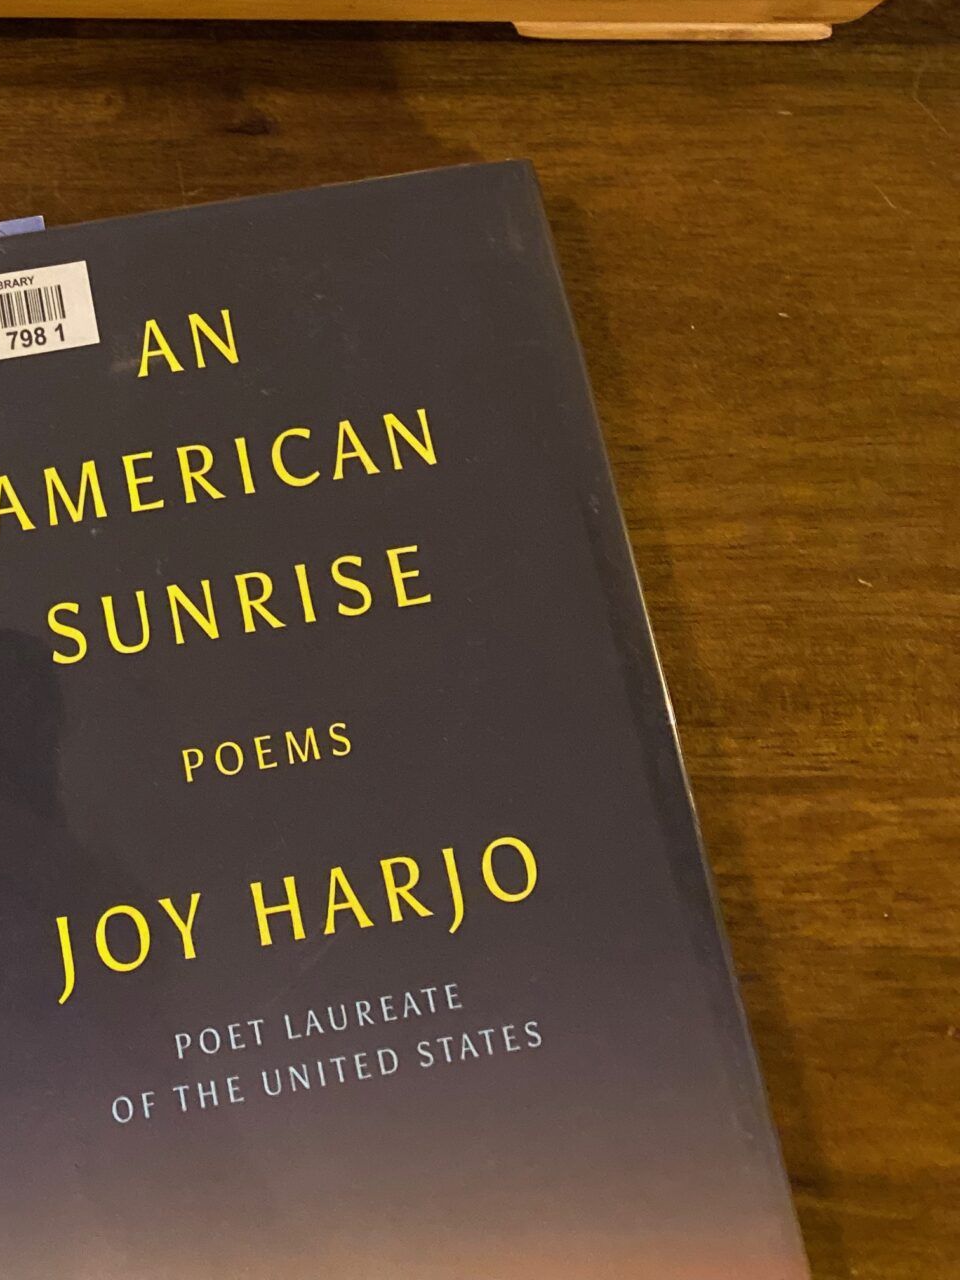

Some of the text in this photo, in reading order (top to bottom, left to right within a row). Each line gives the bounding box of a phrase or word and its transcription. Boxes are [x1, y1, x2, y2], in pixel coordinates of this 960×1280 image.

[5, 326, 48, 351] 798
[53, 322, 67, 342] 1
[136, 308, 241, 379] AN
[46, 543, 433, 665] SUNRISE
[181, 721, 354, 783] POEMS
[55, 835, 540, 1005] JOY HARJO
[174, 982, 464, 1059] POET LAUREATE
[110, 1020, 544, 1124] OF THE UNITED STATES
